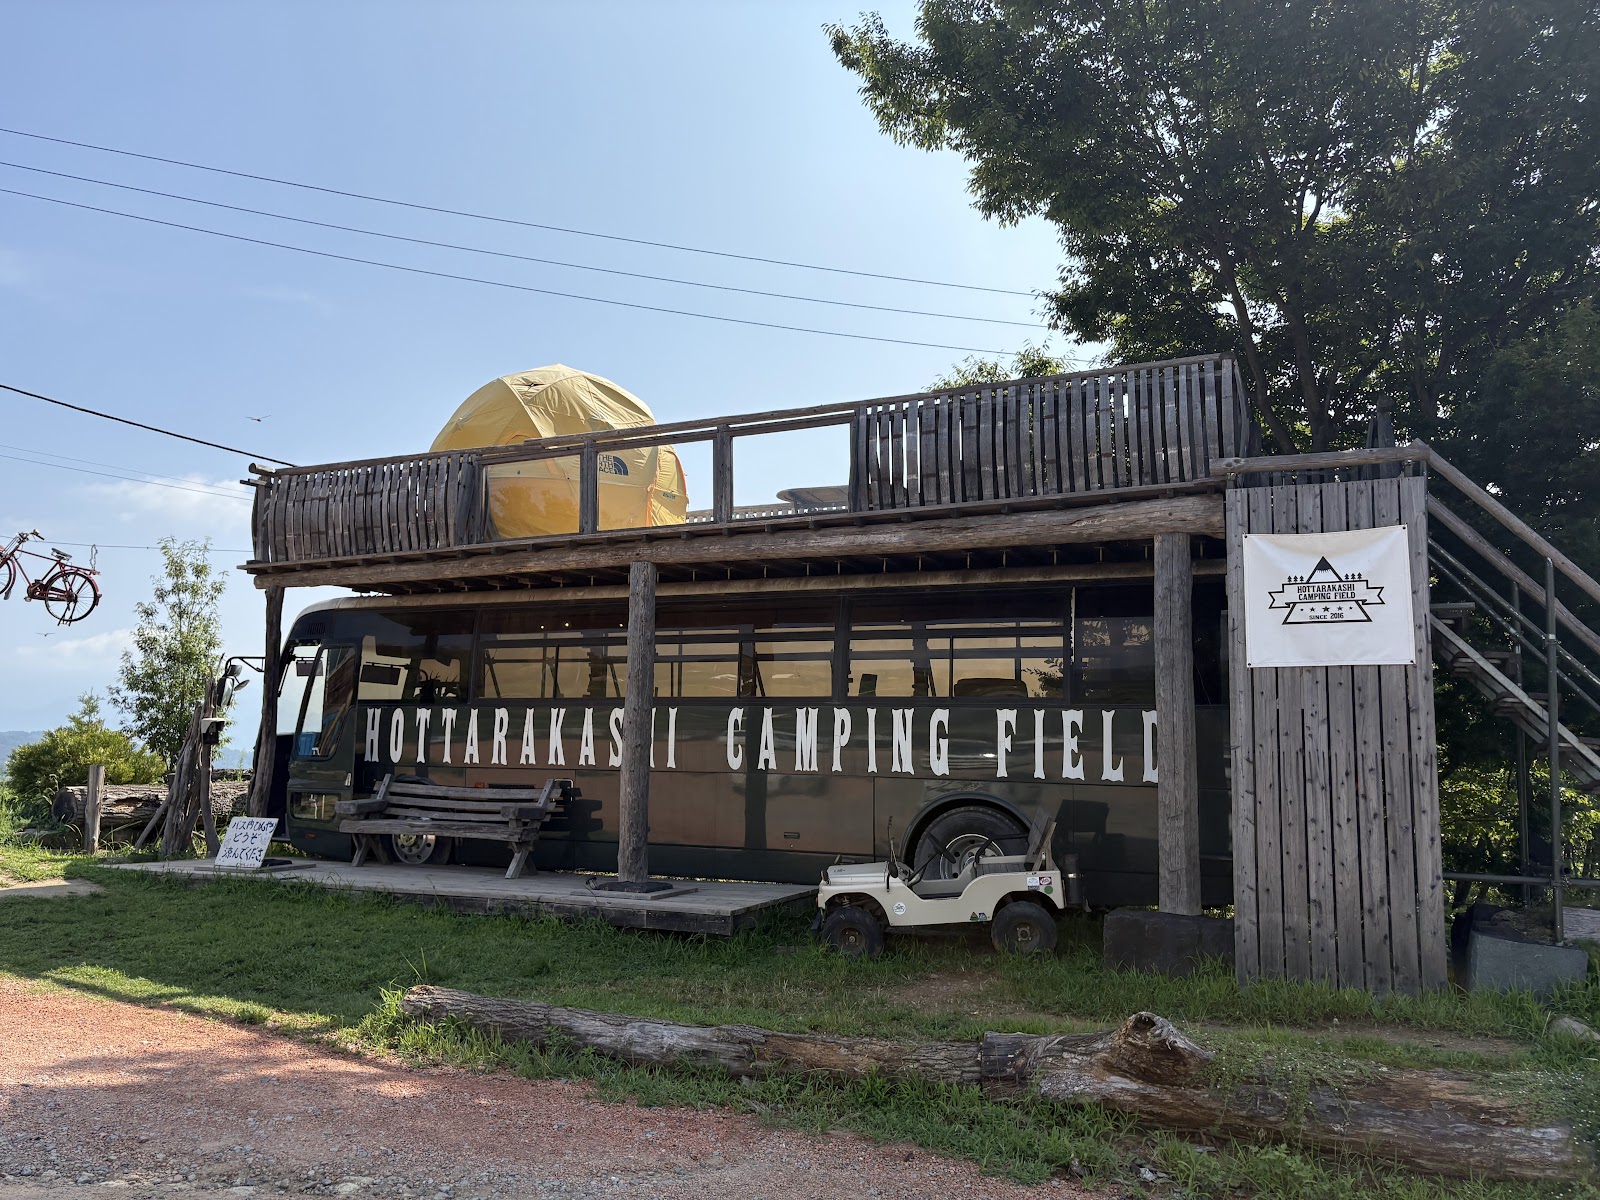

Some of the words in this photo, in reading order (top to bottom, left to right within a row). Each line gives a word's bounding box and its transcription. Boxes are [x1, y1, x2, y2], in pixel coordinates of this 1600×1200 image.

[1297, 583, 1355, 594] HOTTARAKASHI
[1298, 592, 1331, 601] CAMPING
[1334, 591, 1356, 599] FIELD
[363, 706, 678, 769] HOTTARAKASI
[726, 706, 950, 776] CAMPING
